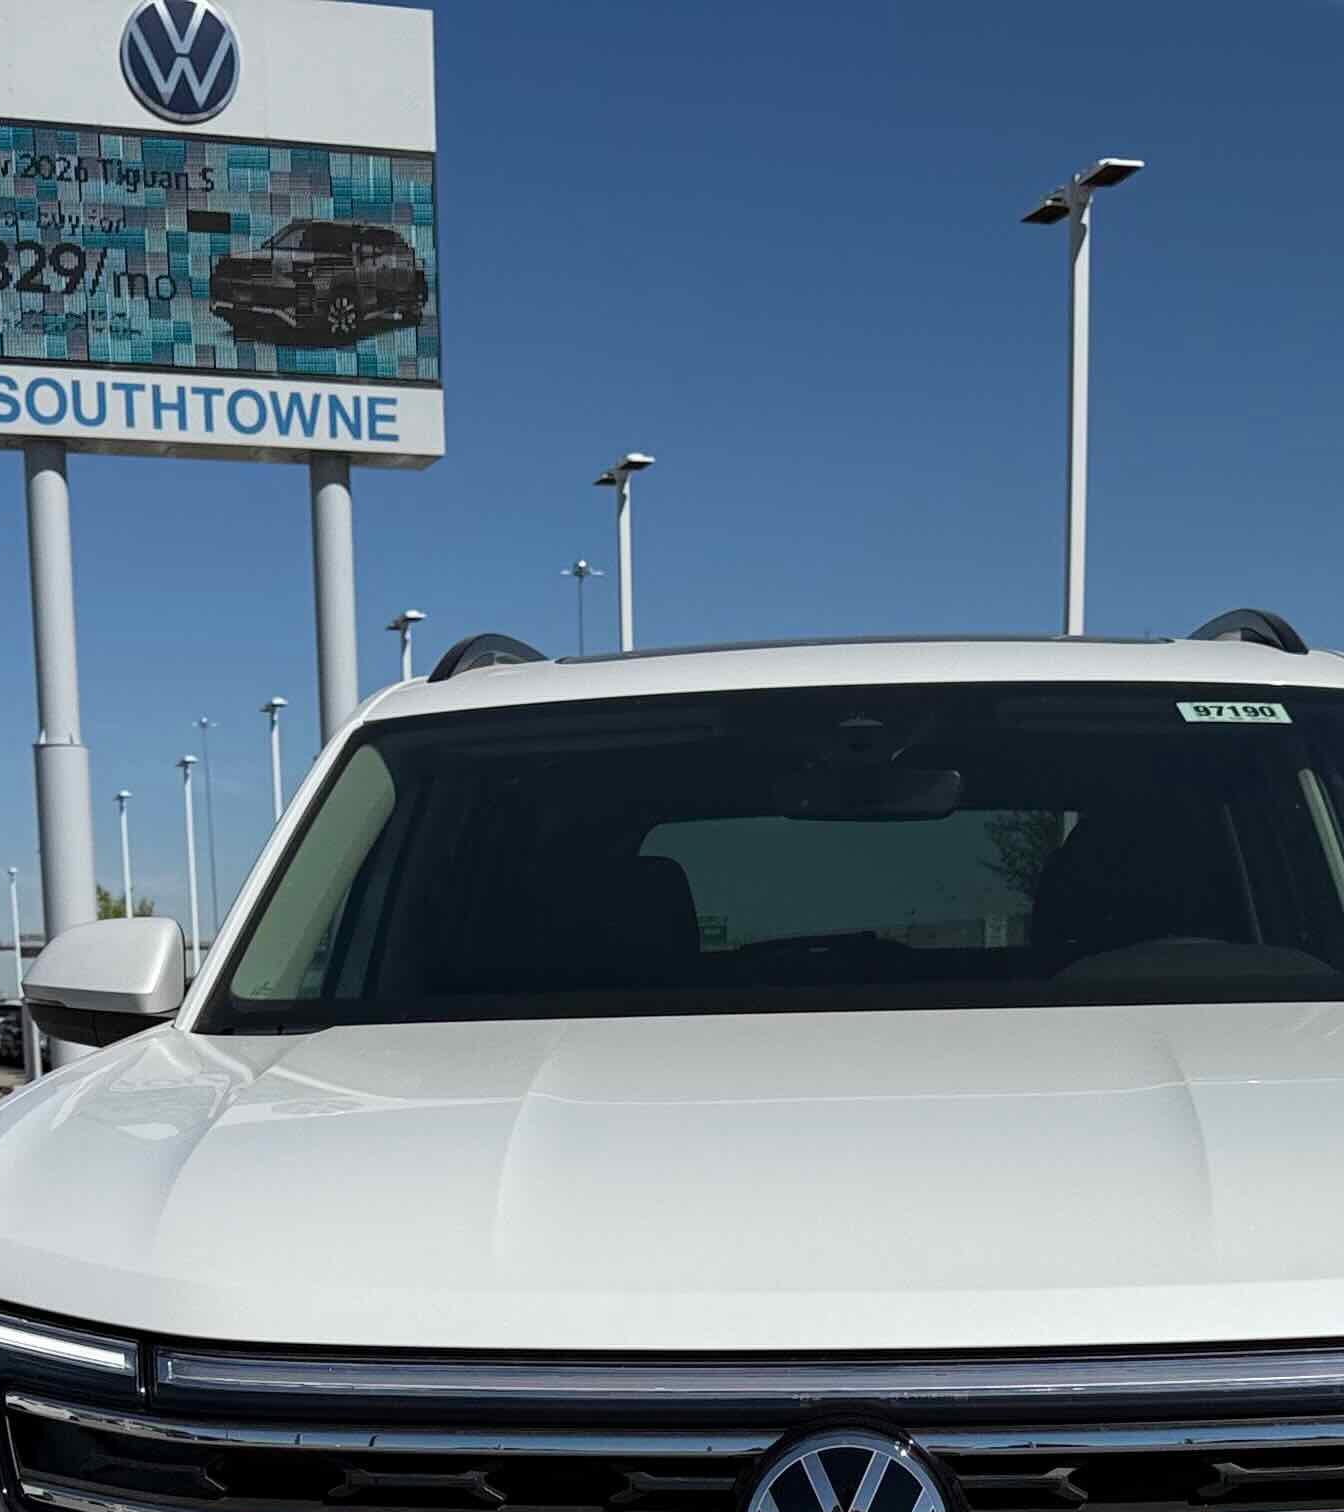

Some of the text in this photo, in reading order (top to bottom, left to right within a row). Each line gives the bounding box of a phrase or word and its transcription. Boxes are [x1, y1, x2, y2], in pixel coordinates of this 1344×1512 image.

[20, 153, 88, 183] 2026
[97, 158, 187, 193] Tiguan
[199, 167, 215, 192] S
[1193, 705, 1276, 718] 97190
